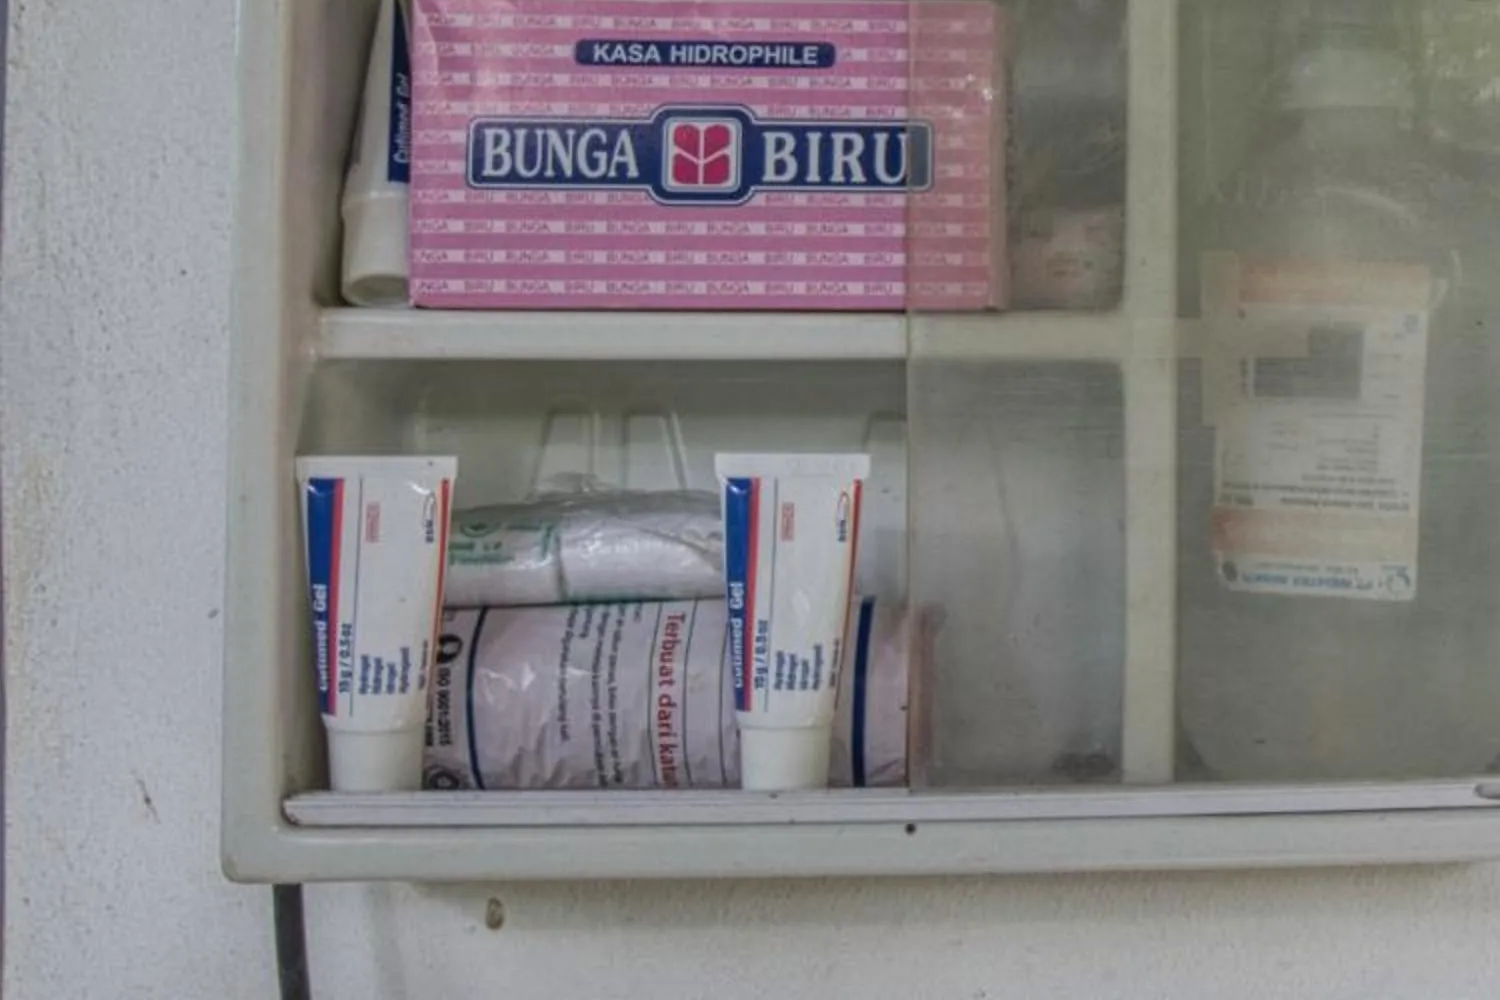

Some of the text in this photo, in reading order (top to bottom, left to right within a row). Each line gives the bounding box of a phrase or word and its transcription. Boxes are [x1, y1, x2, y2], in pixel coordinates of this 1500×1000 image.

[593, 43, 818, 65] KASA HIDROPHILE
[482, 128, 910, 184] BUNGA BIRU
[312, 583, 327, 612] Gel
[729, 582, 744, 610] Gel
[659, 611, 687, 687] Terbuat
[437, 667, 451, 686] ISO
[659, 693, 678, 737] dari
